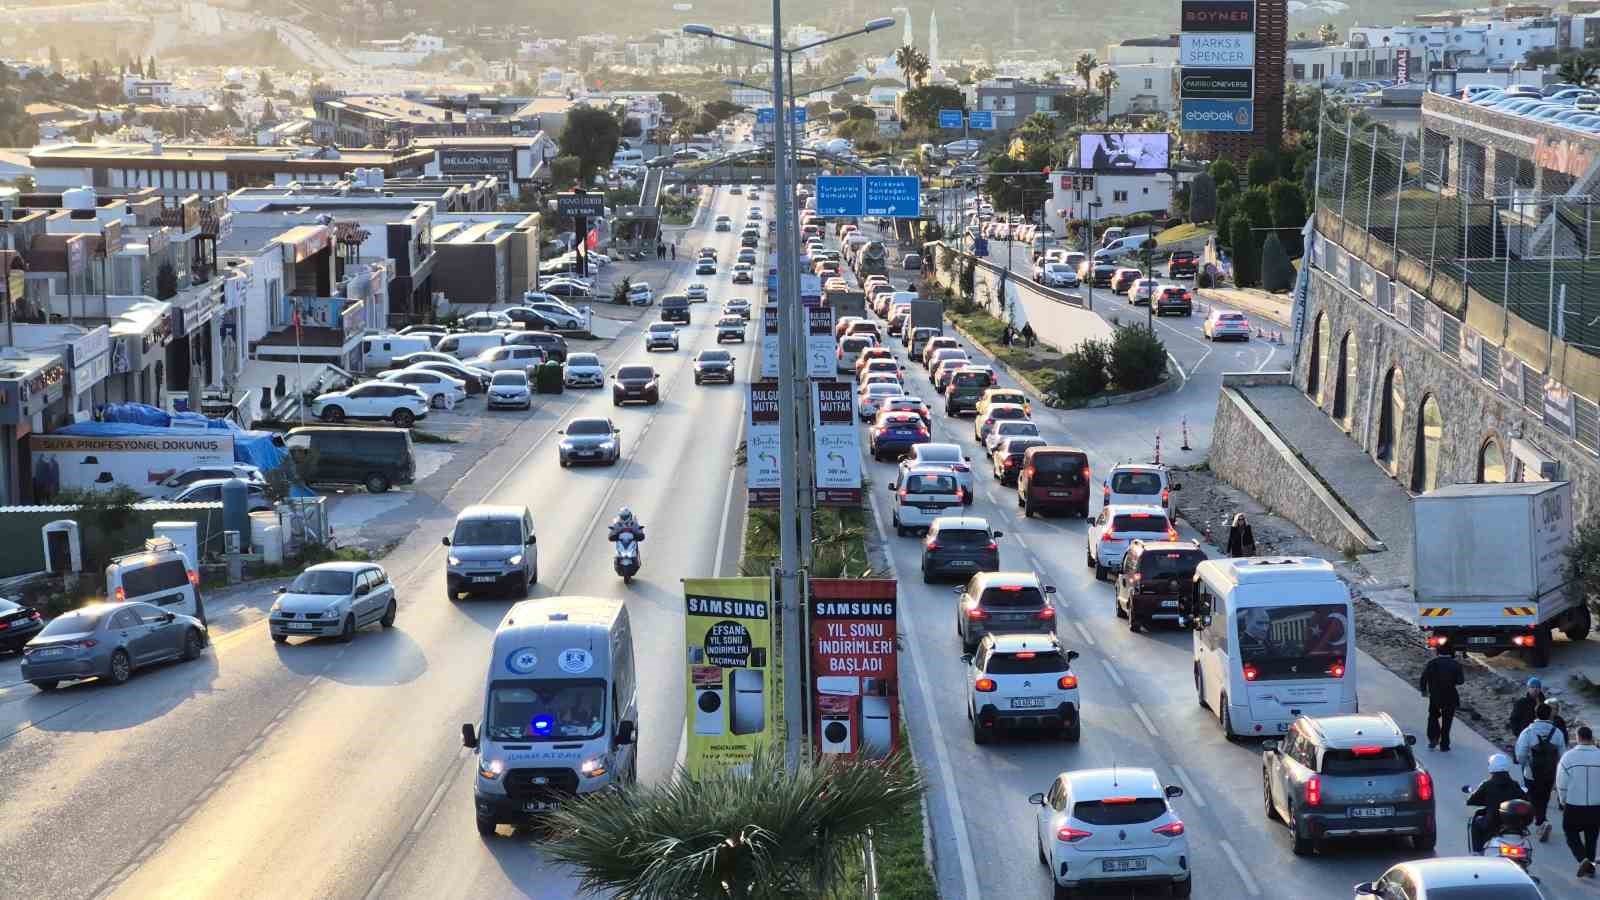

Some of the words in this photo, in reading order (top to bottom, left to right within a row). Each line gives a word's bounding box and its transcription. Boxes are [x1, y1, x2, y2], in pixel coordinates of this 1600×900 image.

[1185, 11, 1249, 21] BOYNER
[1192, 39, 1231, 48] MARKS
[1234, 39, 1240, 47] &
[1191, 51, 1244, 61] SPENCER
[1185, 110, 1234, 121] ebebek
[820, 390, 850, 401] BULGUR
[821, 401, 851, 412] MUTFAK
[79, 440, 159, 450] PROFESYONEL
[689, 598, 765, 617] SAMSUNG
[816, 602, 893, 615] SAMSUNG
[713, 625, 746, 635] EFSANE
[828, 623, 847, 637] YIL
[850, 623, 882, 637] SONU
[710, 636, 721, 644] YIL
[819, 638, 892, 654] İNDİRİMLERİ
[830, 658, 882, 674] BAŞLADI
